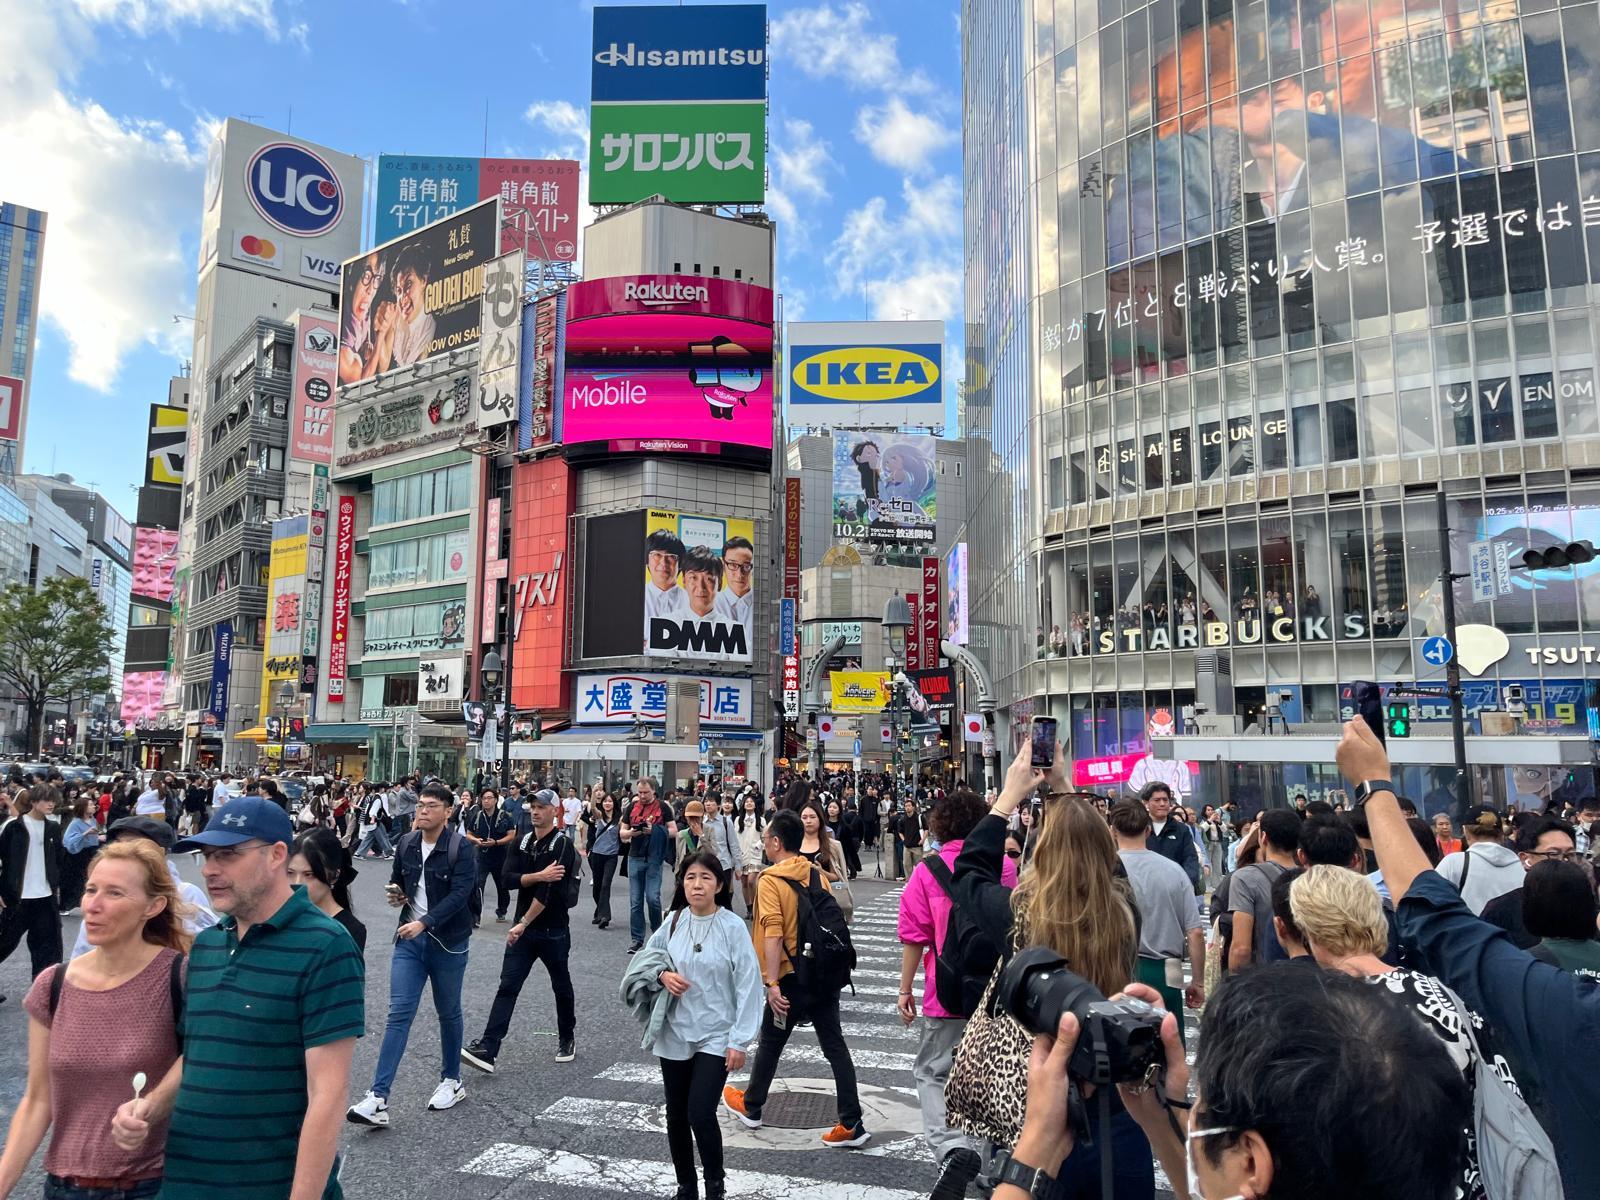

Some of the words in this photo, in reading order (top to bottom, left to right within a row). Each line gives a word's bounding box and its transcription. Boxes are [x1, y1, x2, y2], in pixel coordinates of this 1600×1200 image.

[595, 43, 763, 66] Hisamitsu
[601, 132, 754, 172] サロンパス
[259, 160, 333, 216] UC
[400, 177, 458, 202] 龍角散
[501, 180, 559, 205] 龍角散
[444, 257, 456, 267] New
[457, 249, 474, 261] Single
[425, 272, 461, 314] GOLDEN
[625, 281, 708, 303] Rakuten
[426, 337, 446, 354] NOW
[448, 332, 462, 347] ON
[464, 326, 481, 342] SAL
[806, 362, 929, 385] IKEA
[572, 380, 647, 409] Mobile
[640, 441, 666, 449] Rakuten
[1202, 420, 1287, 446] LOUNGE
[788, 481, 798, 559] クスリのことなら
[835, 523, 865, 538] 10.2
[896, 528, 934, 539] 放送開始
[1479, 545, 1492, 597] 渋谷駅前
[275, 592, 299, 632] 薬
[924, 566, 937, 630] カラオケ
[220, 632, 229, 661] MIZUHO
[364, 638, 439, 652] ジャスミンレディースクリニック
[650, 618, 748, 654] DMM
[824, 635, 861, 643] クック
[1100, 613, 1365, 653] STARBUCKS
[926, 637, 935, 669] BIGECH
[1526, 646, 1600, 664] TSUT
[585, 682, 740, 714] 大盛堂店
